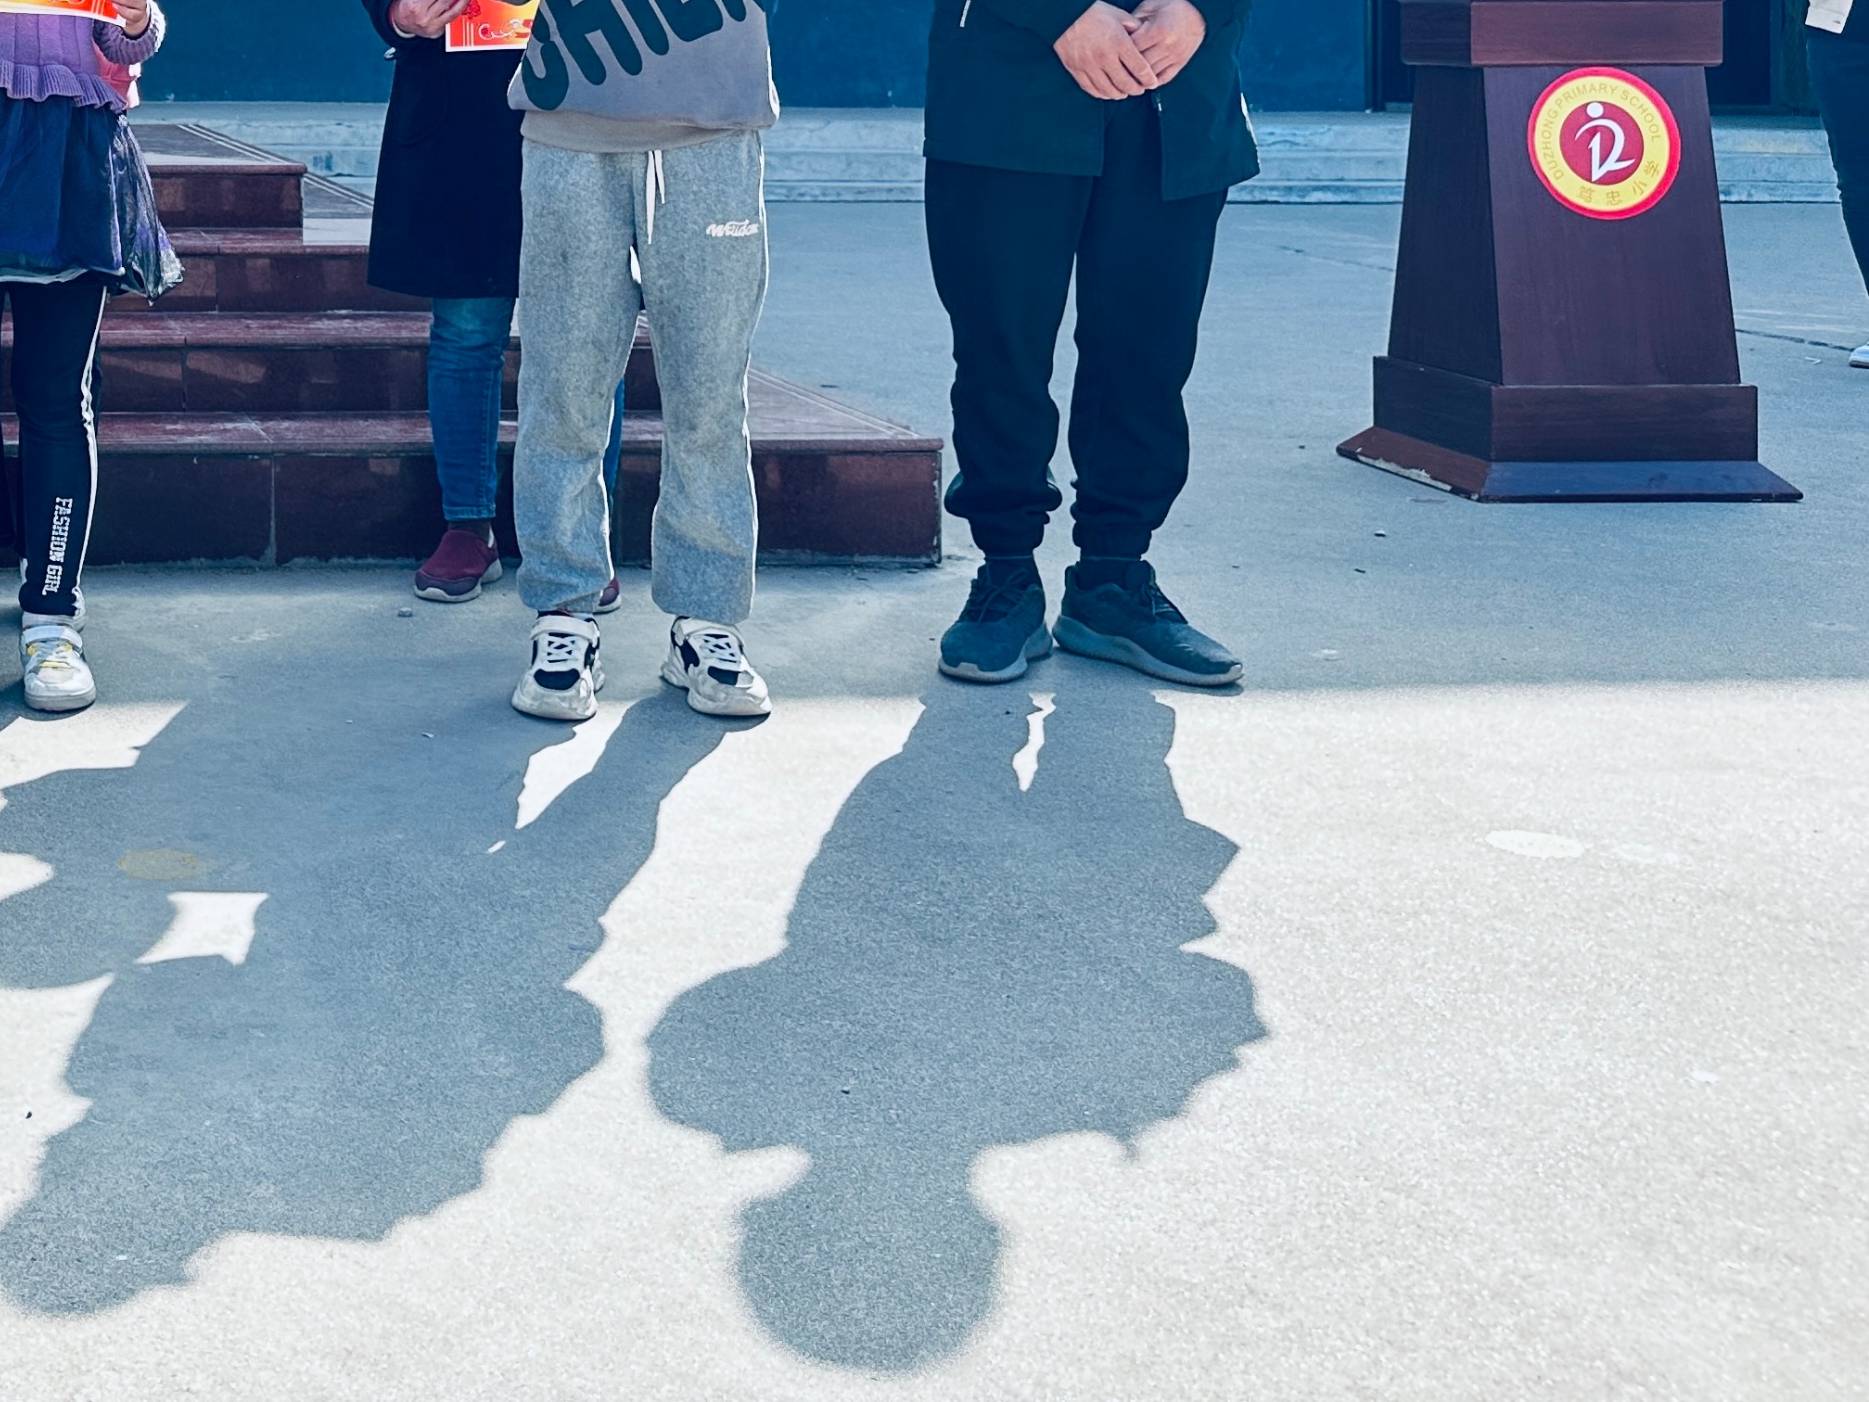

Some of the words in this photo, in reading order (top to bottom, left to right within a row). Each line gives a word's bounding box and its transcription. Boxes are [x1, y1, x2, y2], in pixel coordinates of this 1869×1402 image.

[1541, 108, 1564, 181] DUZHONG
[1554, 83, 1618, 110] PRIMARY
[1620, 89, 1662, 143] SCHOOL
[49, 497, 74, 563] FASHION
[42, 564, 63, 596] GIRL
